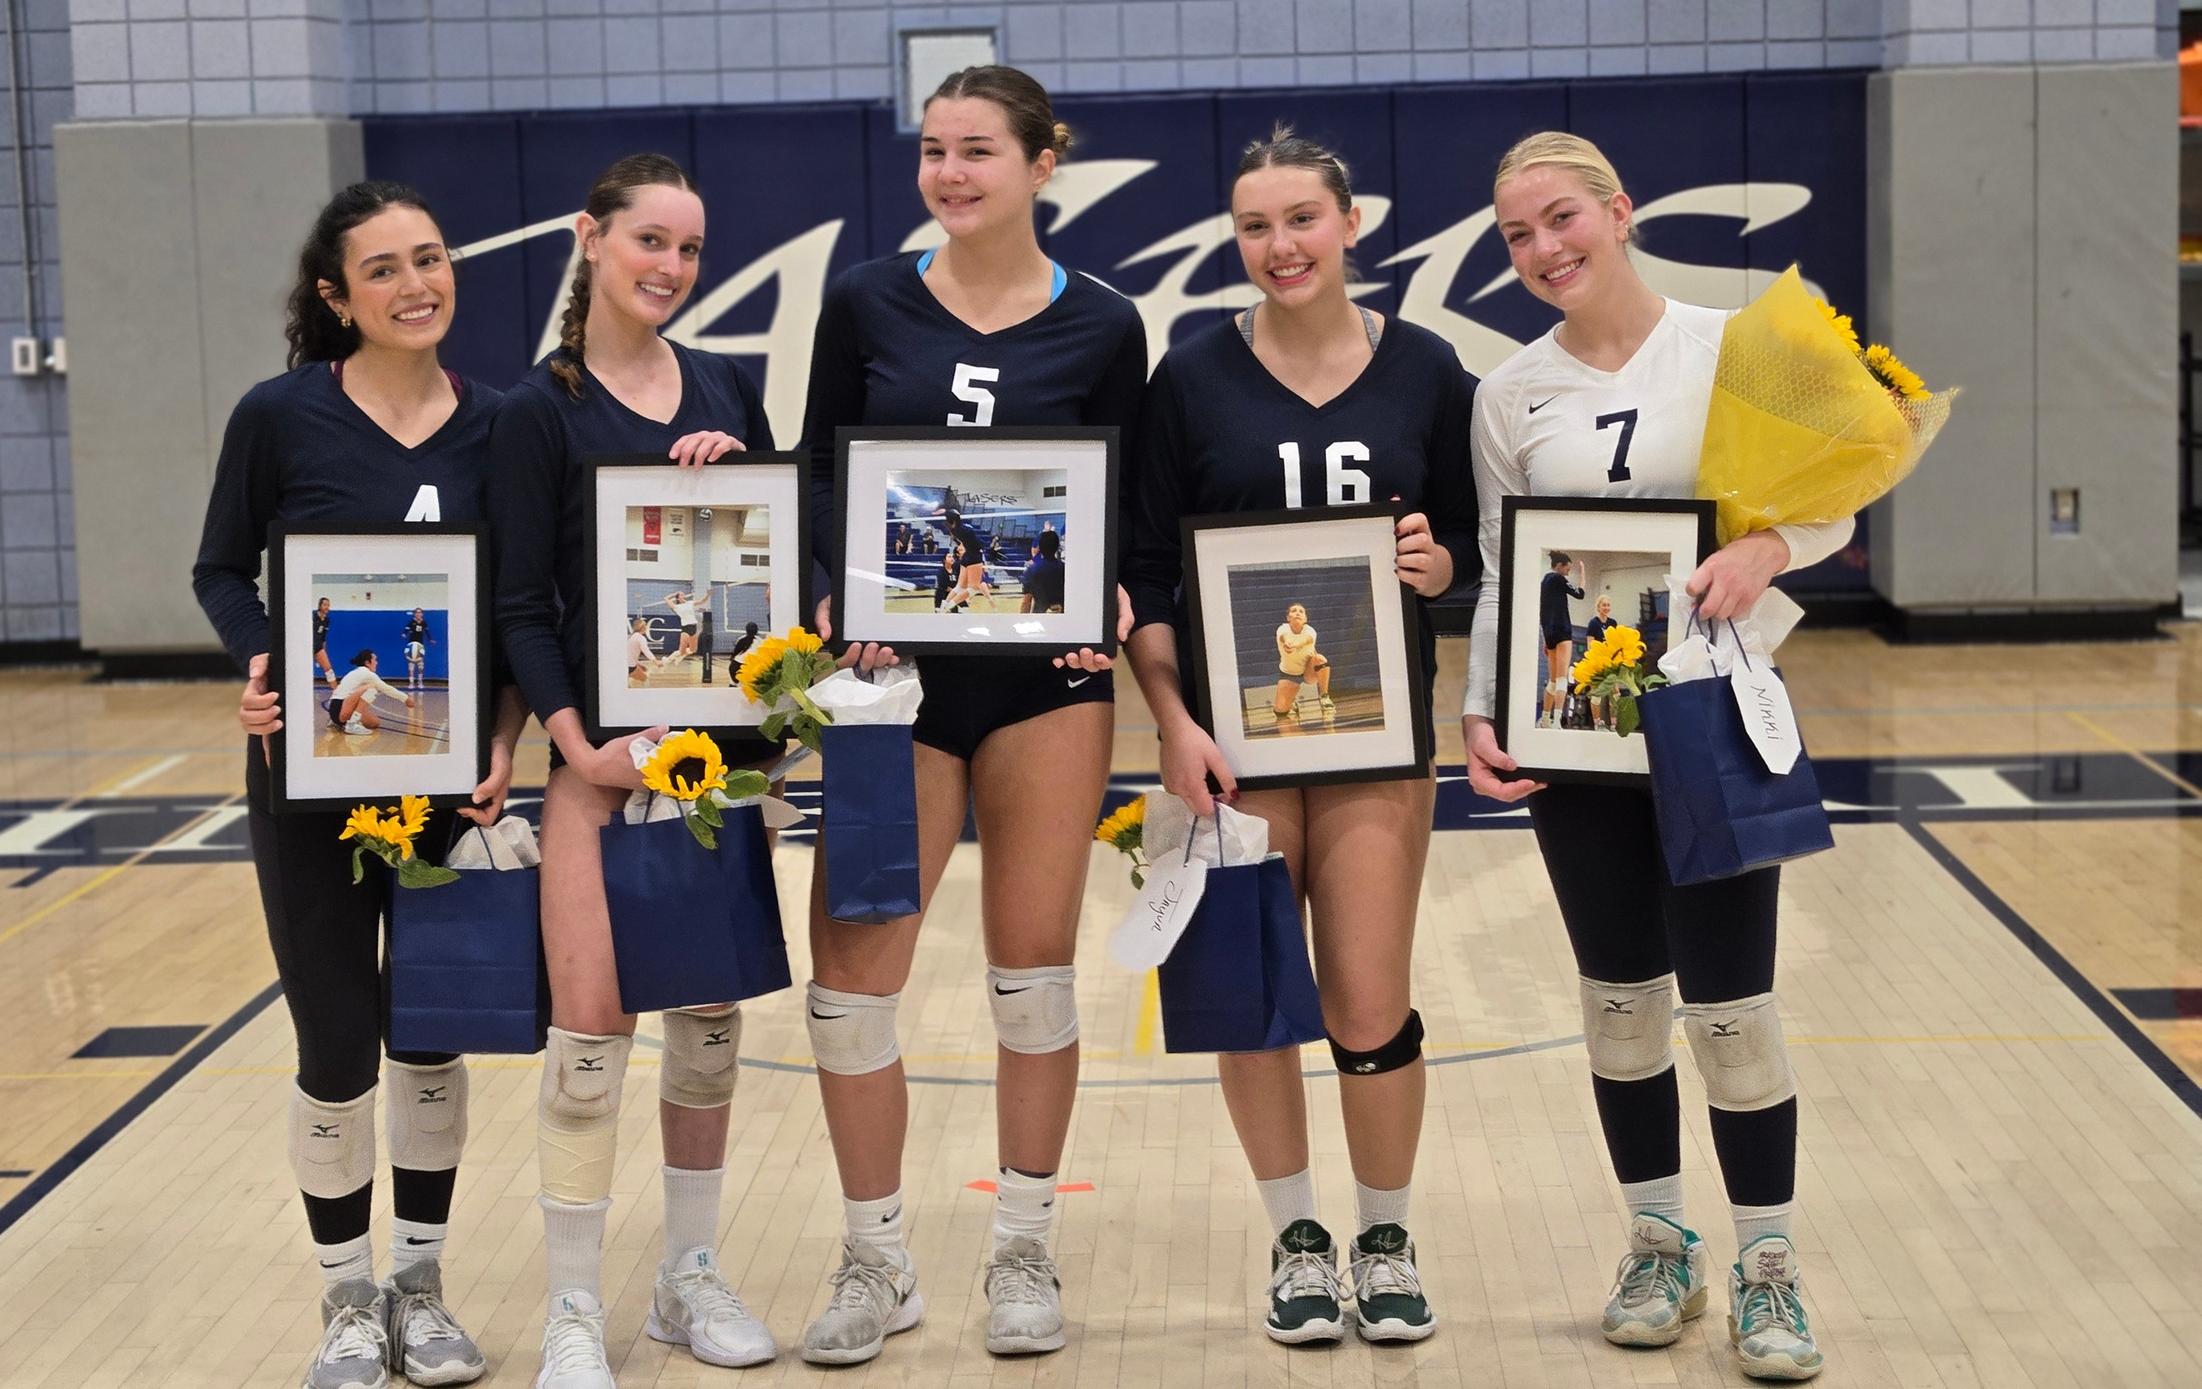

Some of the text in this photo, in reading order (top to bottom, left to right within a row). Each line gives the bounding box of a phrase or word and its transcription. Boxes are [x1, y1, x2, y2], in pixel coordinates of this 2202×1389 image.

[947, 363, 1000, 427] 5
[1278, 441, 1370, 509] 16
[1596, 408, 1638, 483] 7
